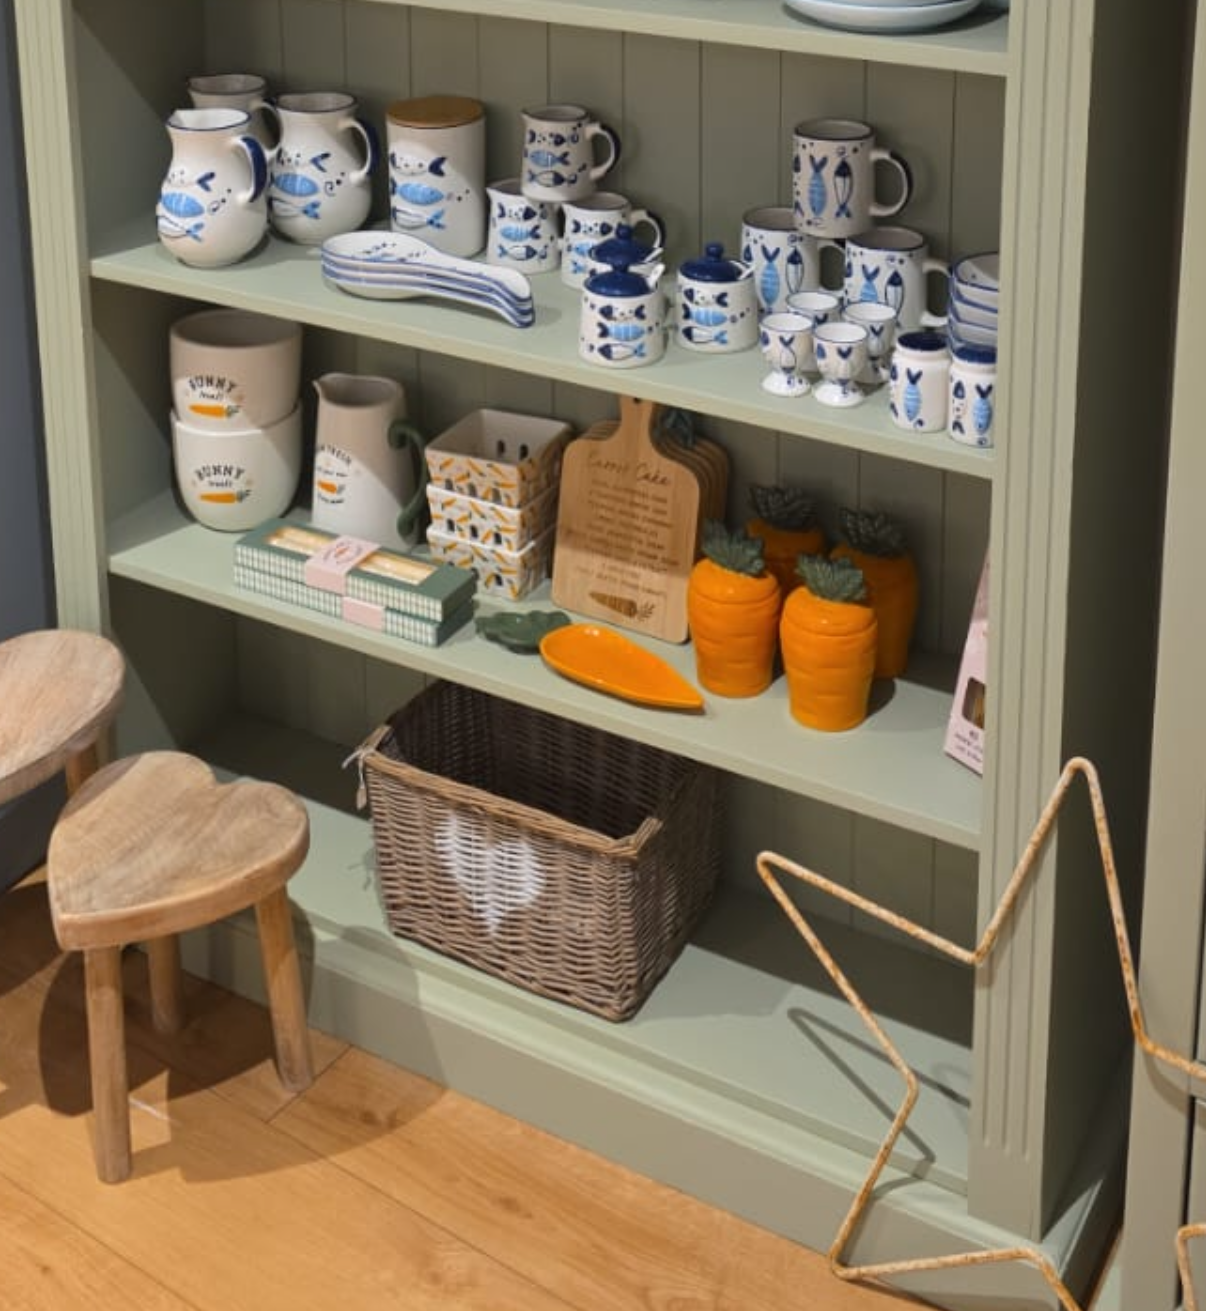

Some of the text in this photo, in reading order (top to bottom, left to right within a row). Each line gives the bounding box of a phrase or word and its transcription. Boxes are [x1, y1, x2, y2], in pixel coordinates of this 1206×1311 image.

[189, 374, 237, 393] BUNNY
[195, 464, 245, 482] BUNNY
[636, 463, 669, 486] Cake
